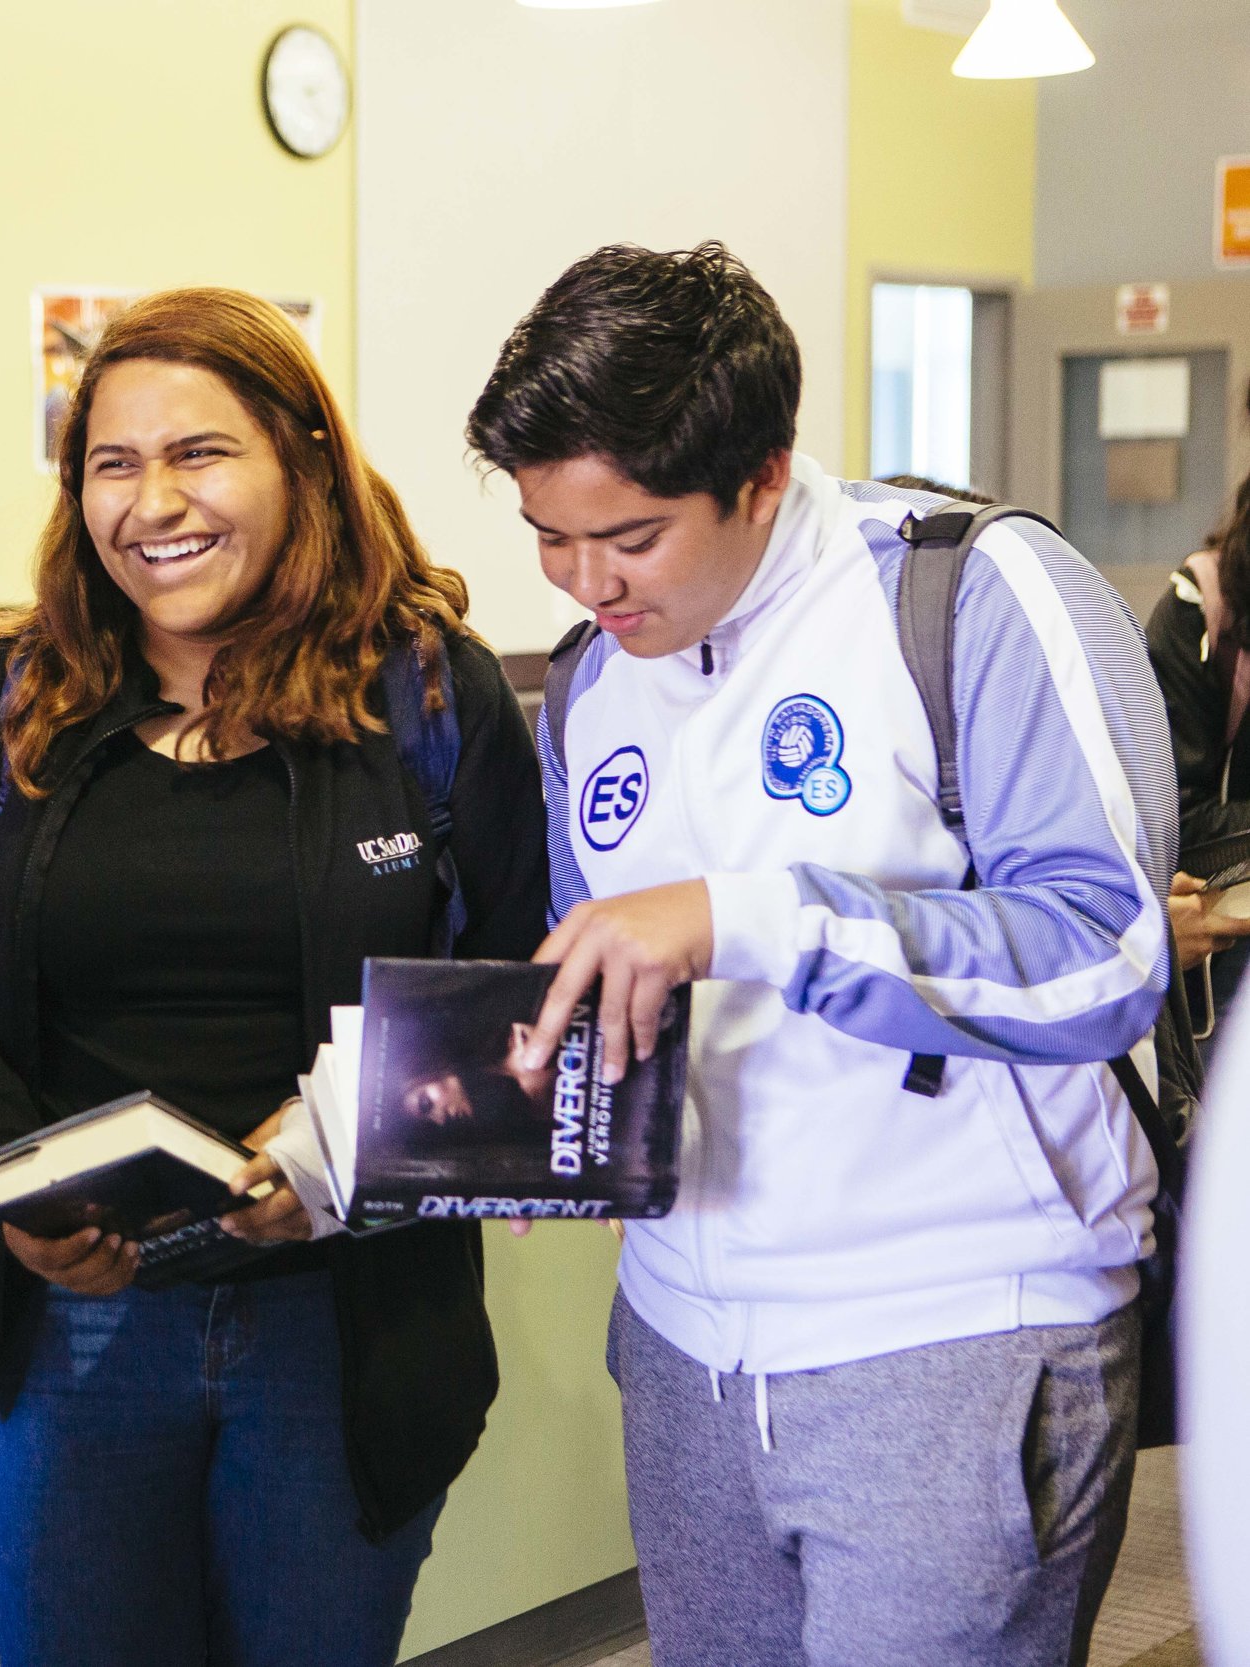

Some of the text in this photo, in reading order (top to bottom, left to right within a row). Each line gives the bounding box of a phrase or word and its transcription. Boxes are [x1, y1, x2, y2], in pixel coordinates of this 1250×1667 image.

[588, 773, 642, 823] ES
[811, 779, 837, 799] ES
[551, 1003, 592, 1176] DIVERGEN
[593, 1086, 614, 1166] VERONI
